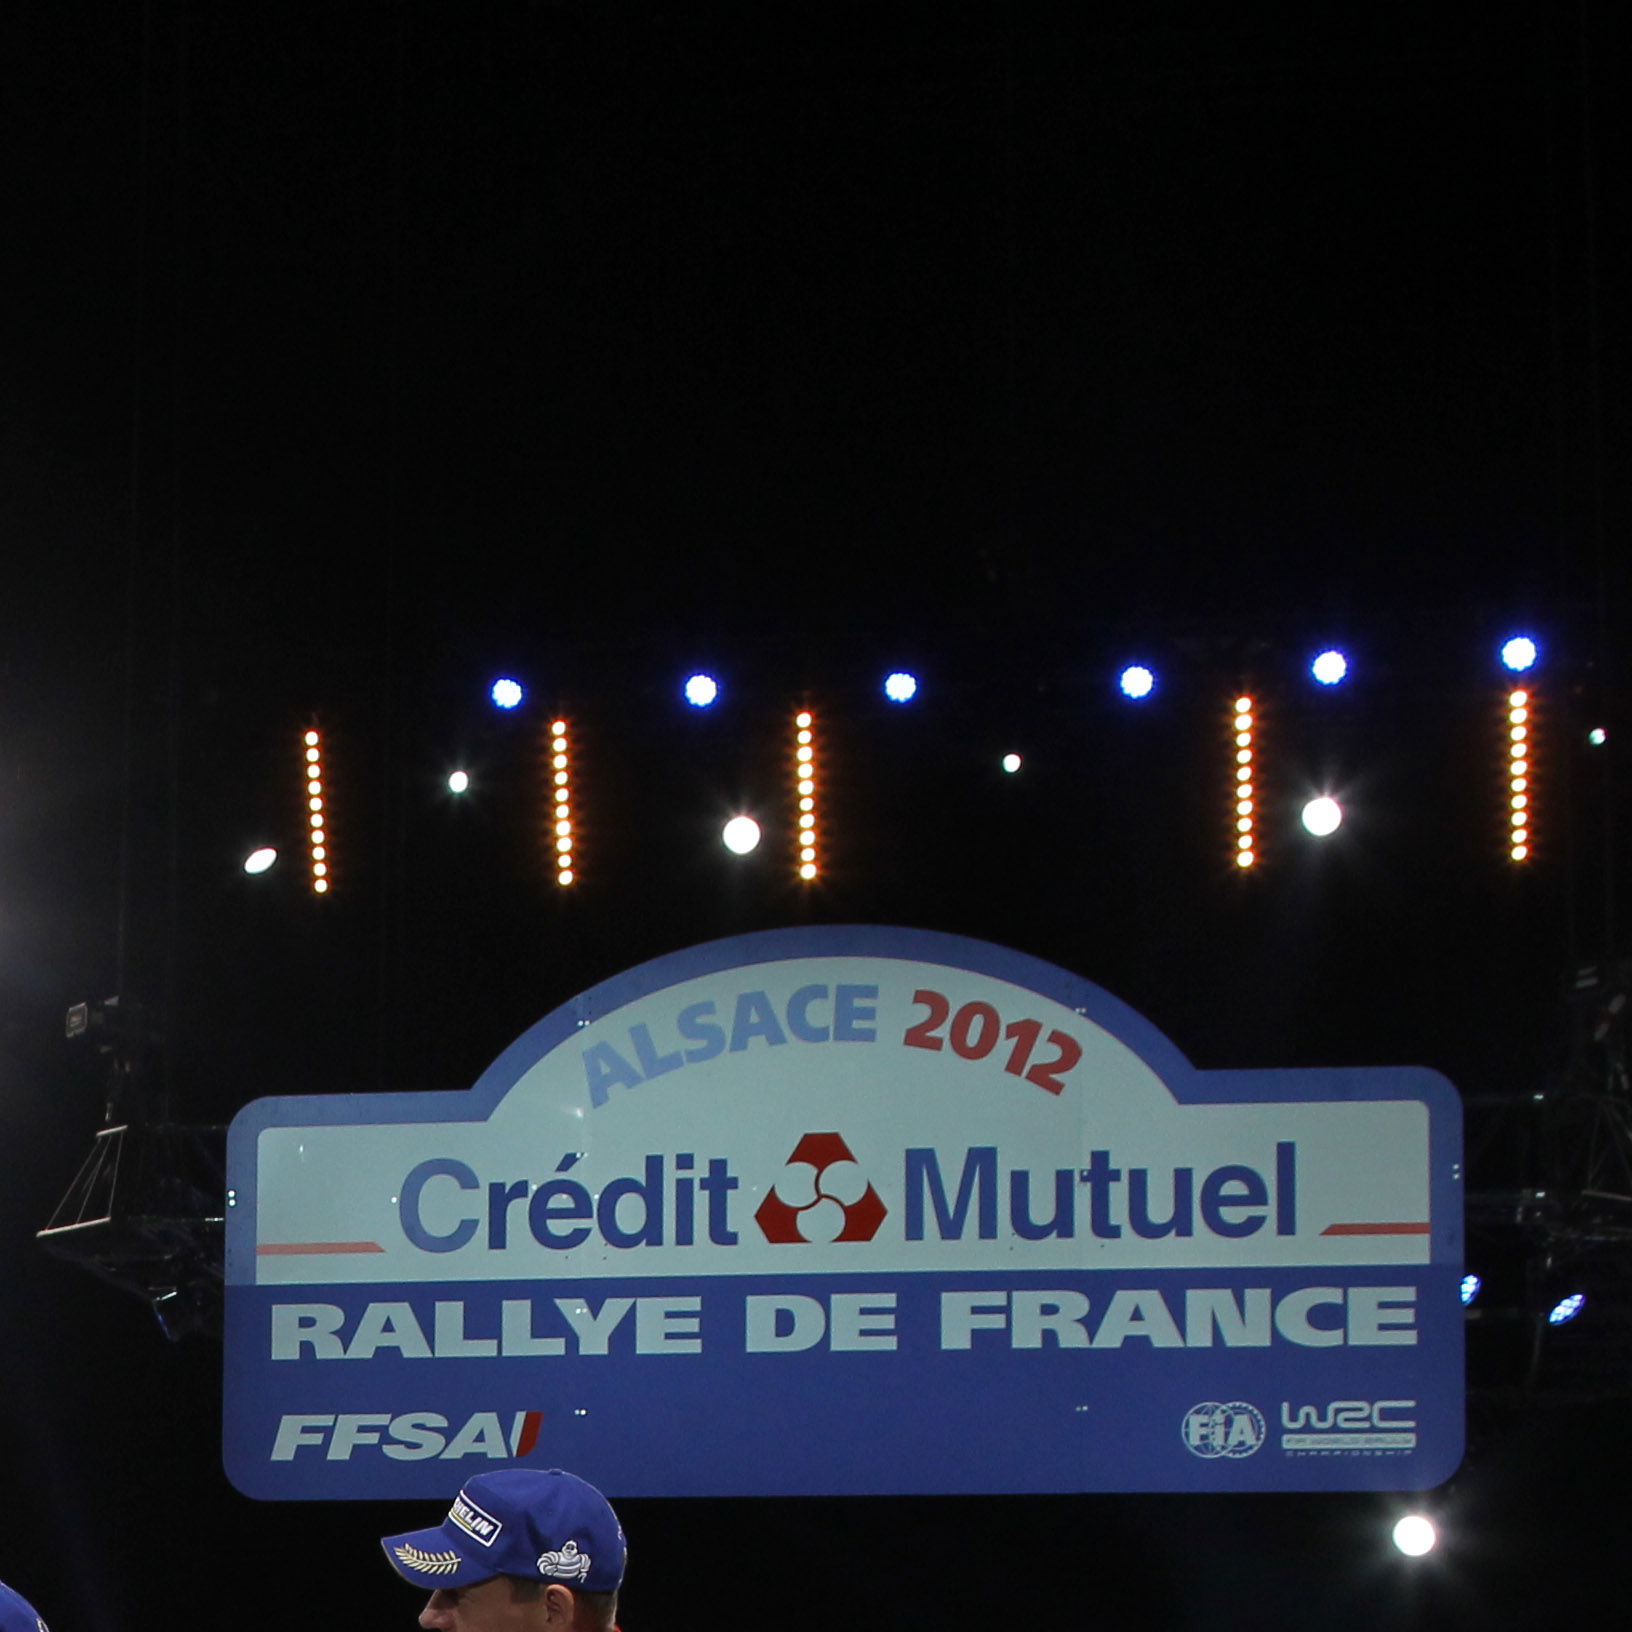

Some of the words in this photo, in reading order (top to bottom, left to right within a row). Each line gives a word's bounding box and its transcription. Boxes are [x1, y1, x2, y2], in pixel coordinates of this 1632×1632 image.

[581, 983, 879, 1108] ALSACE
[903, 988, 1082, 1096] 2012
[398, 1152, 738, 1252] Crédit
[904, 1142, 1296, 1240] Mutuel
[271, 1297, 703, 1359] RALLYE
[745, 1293, 898, 1351] DE
[940, 1286, 1418, 1348] FRANCE
[271, 1412, 514, 1461] FFSA
[1281, 1400, 1416, 1429] WRC
